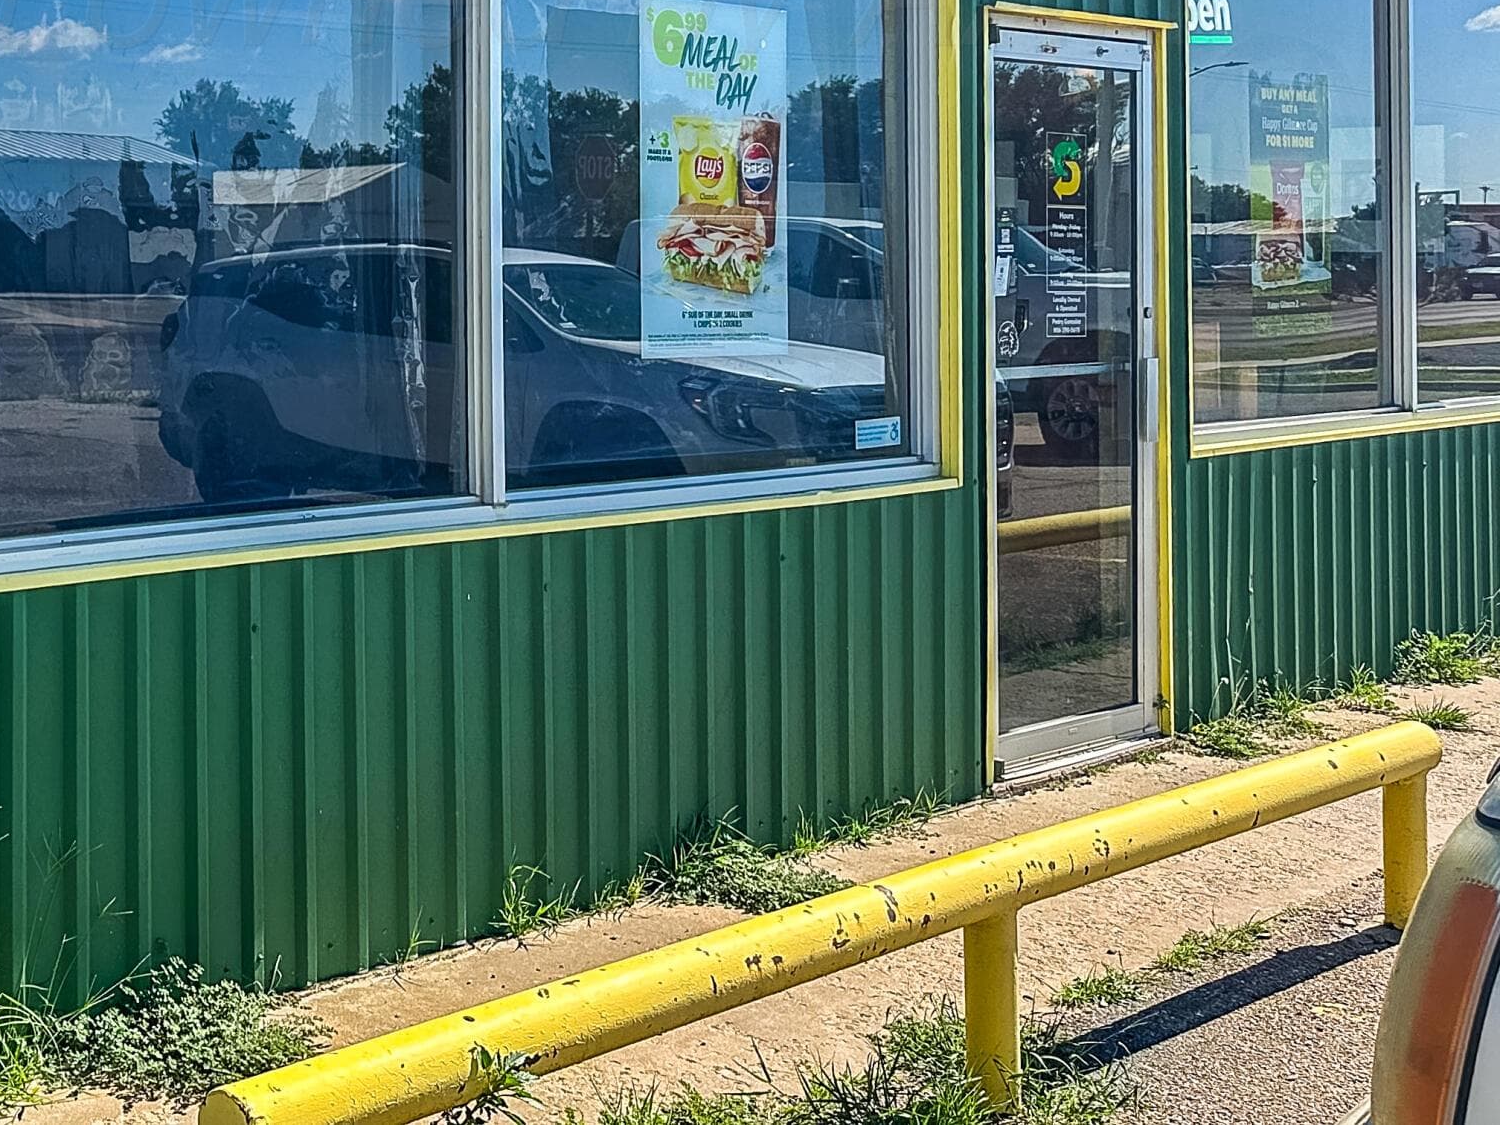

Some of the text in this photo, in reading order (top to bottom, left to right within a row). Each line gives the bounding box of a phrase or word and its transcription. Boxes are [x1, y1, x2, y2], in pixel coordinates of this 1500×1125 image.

[680, 32, 757, 73] MEAL OF
[686, 72, 757, 115] THE DAY
[1260, 87, 1318, 103] BUY ANY MEAL
[1261, 116, 1281, 132] Happy
[1265, 134, 1282, 148] FOR
[1291, 135, 1315, 149] MORE
[696, 156, 722, 179] Lay's
[744, 162, 772, 174] PEPSI
[1276, 182, 1299, 195] Doritos
